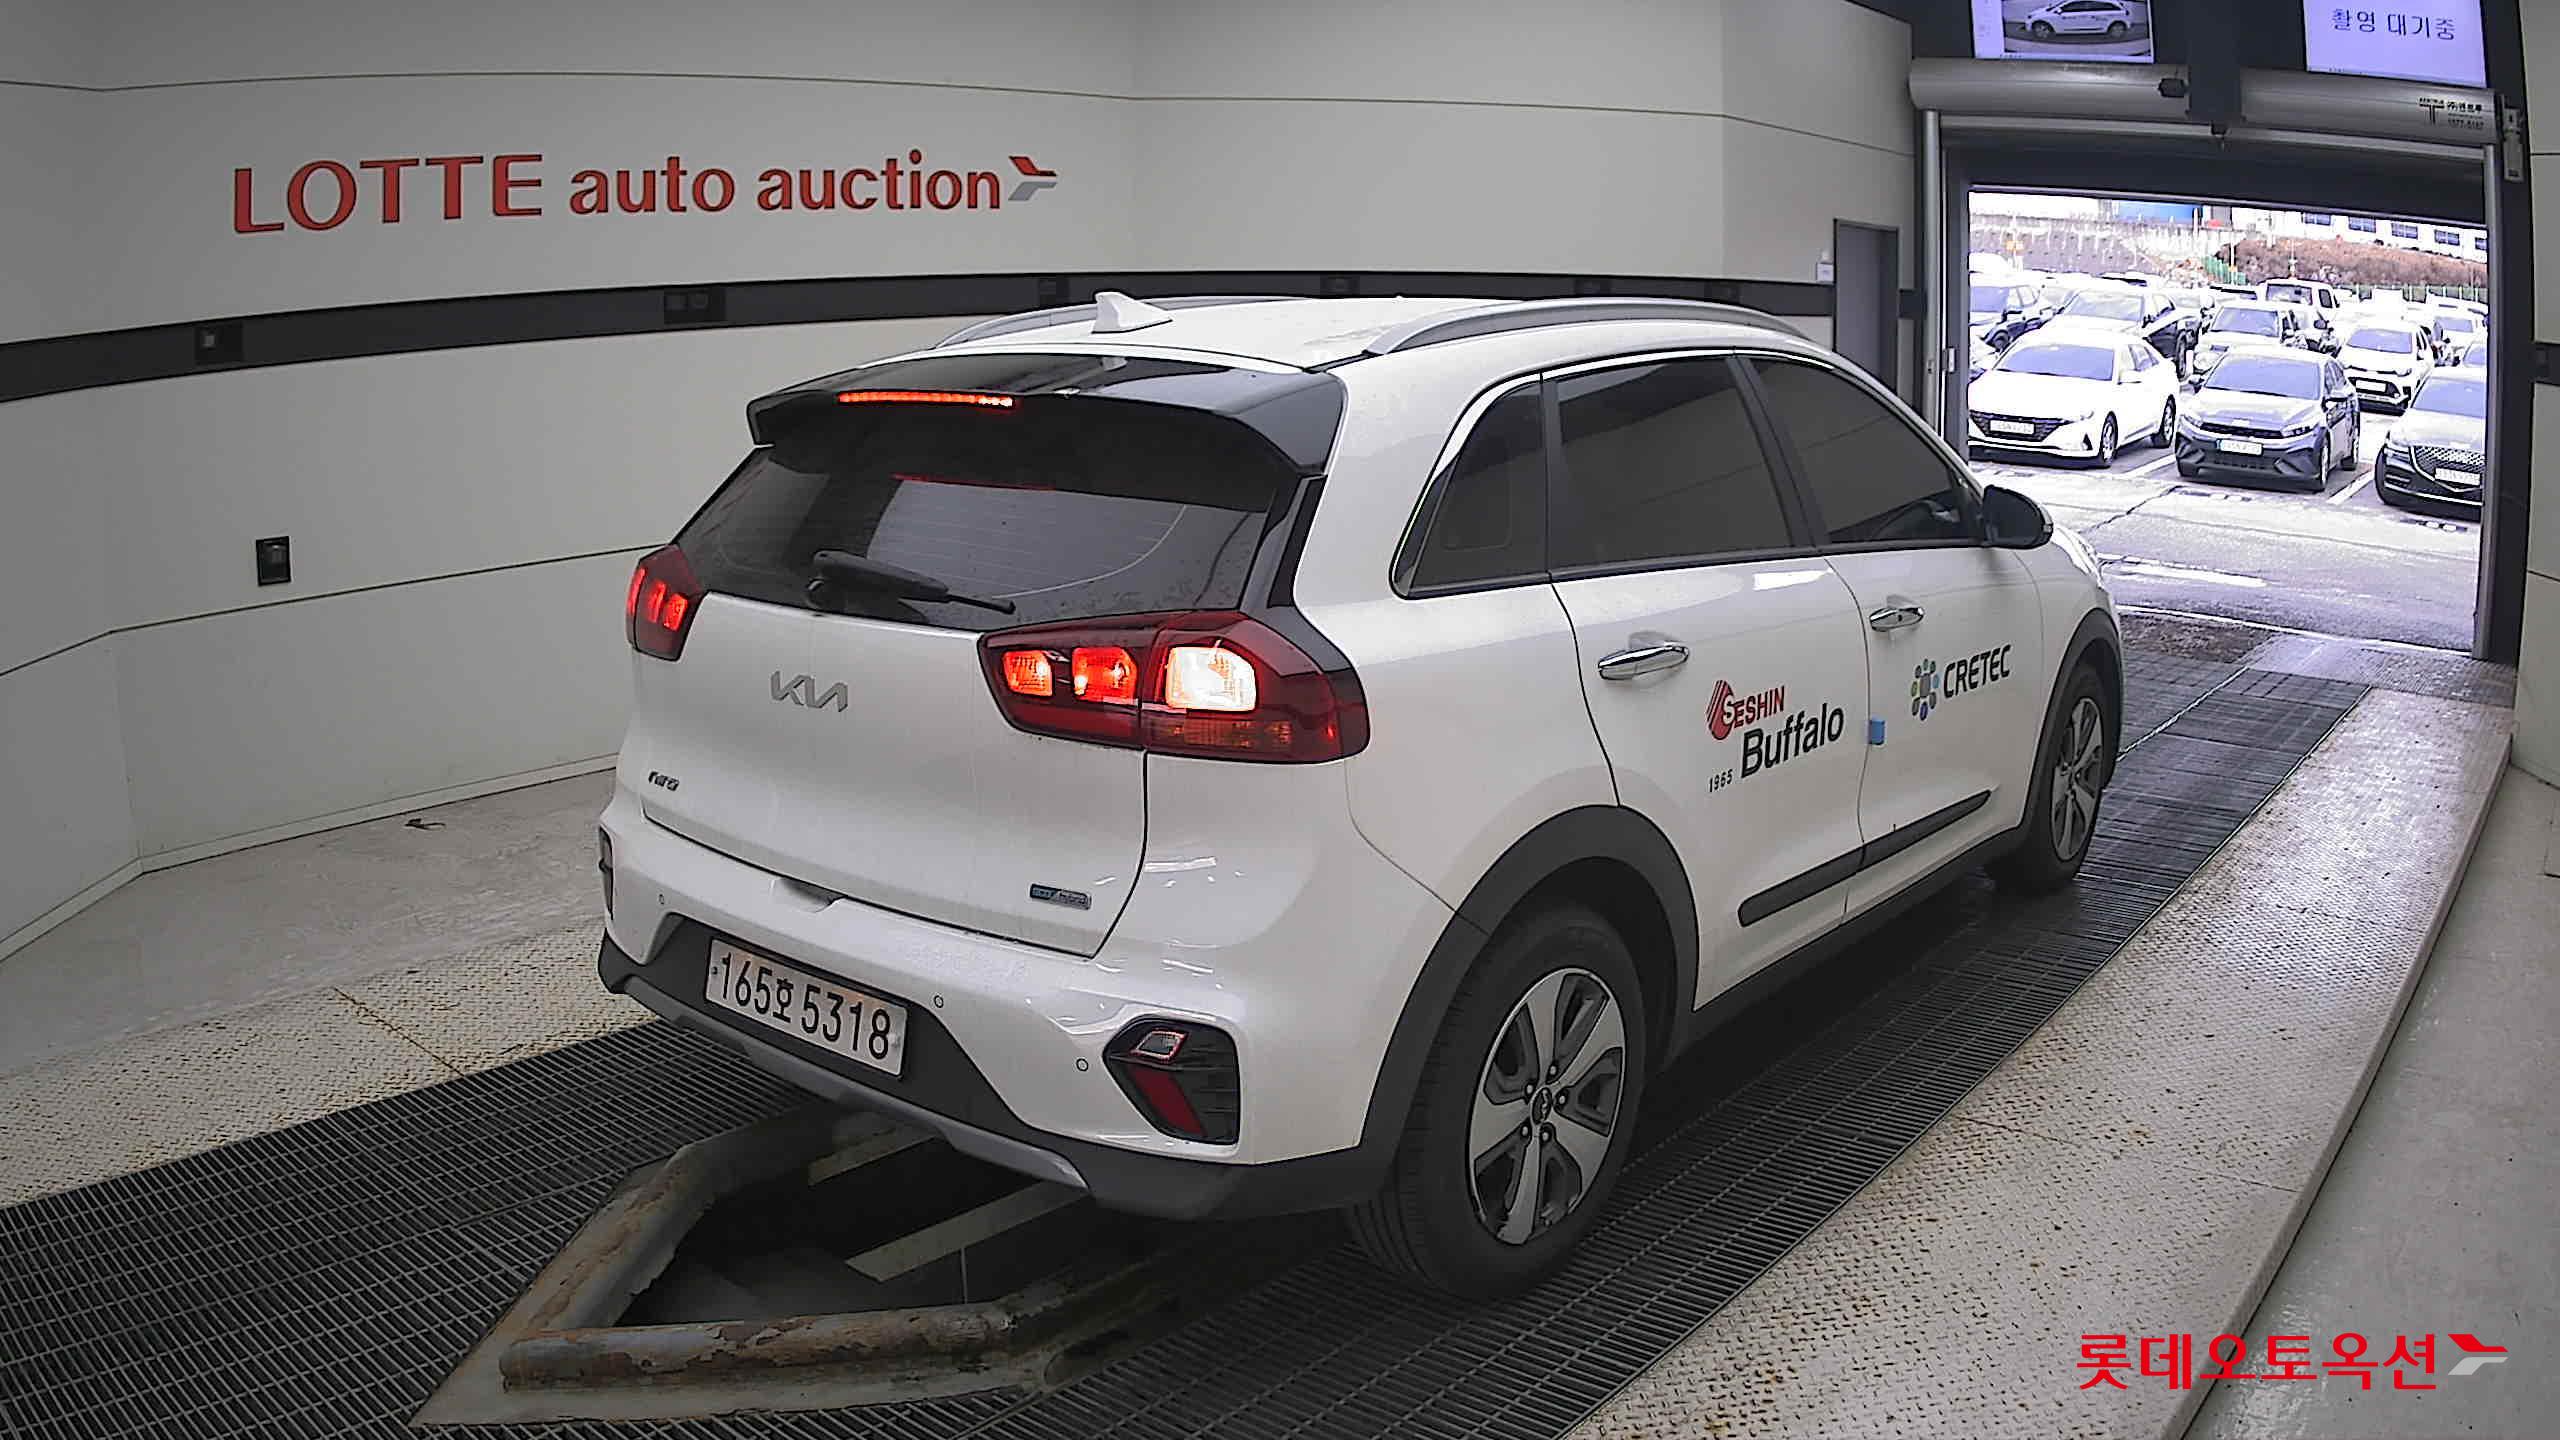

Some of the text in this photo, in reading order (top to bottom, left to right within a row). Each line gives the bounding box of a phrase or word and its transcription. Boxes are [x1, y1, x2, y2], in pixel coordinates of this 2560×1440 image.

[2332, 8, 2455, 41] 촬영 대기중
[234, 148, 1001, 234] LOTTE auto auction
[770, 670, 848, 713] KIA
[1943, 644, 2012, 699] CRETEC
[1741, 702, 1844, 779] Buffalo
[1708, 769, 1733, 793] 1965
[722, 951, 890, 1060] 165호 5318
